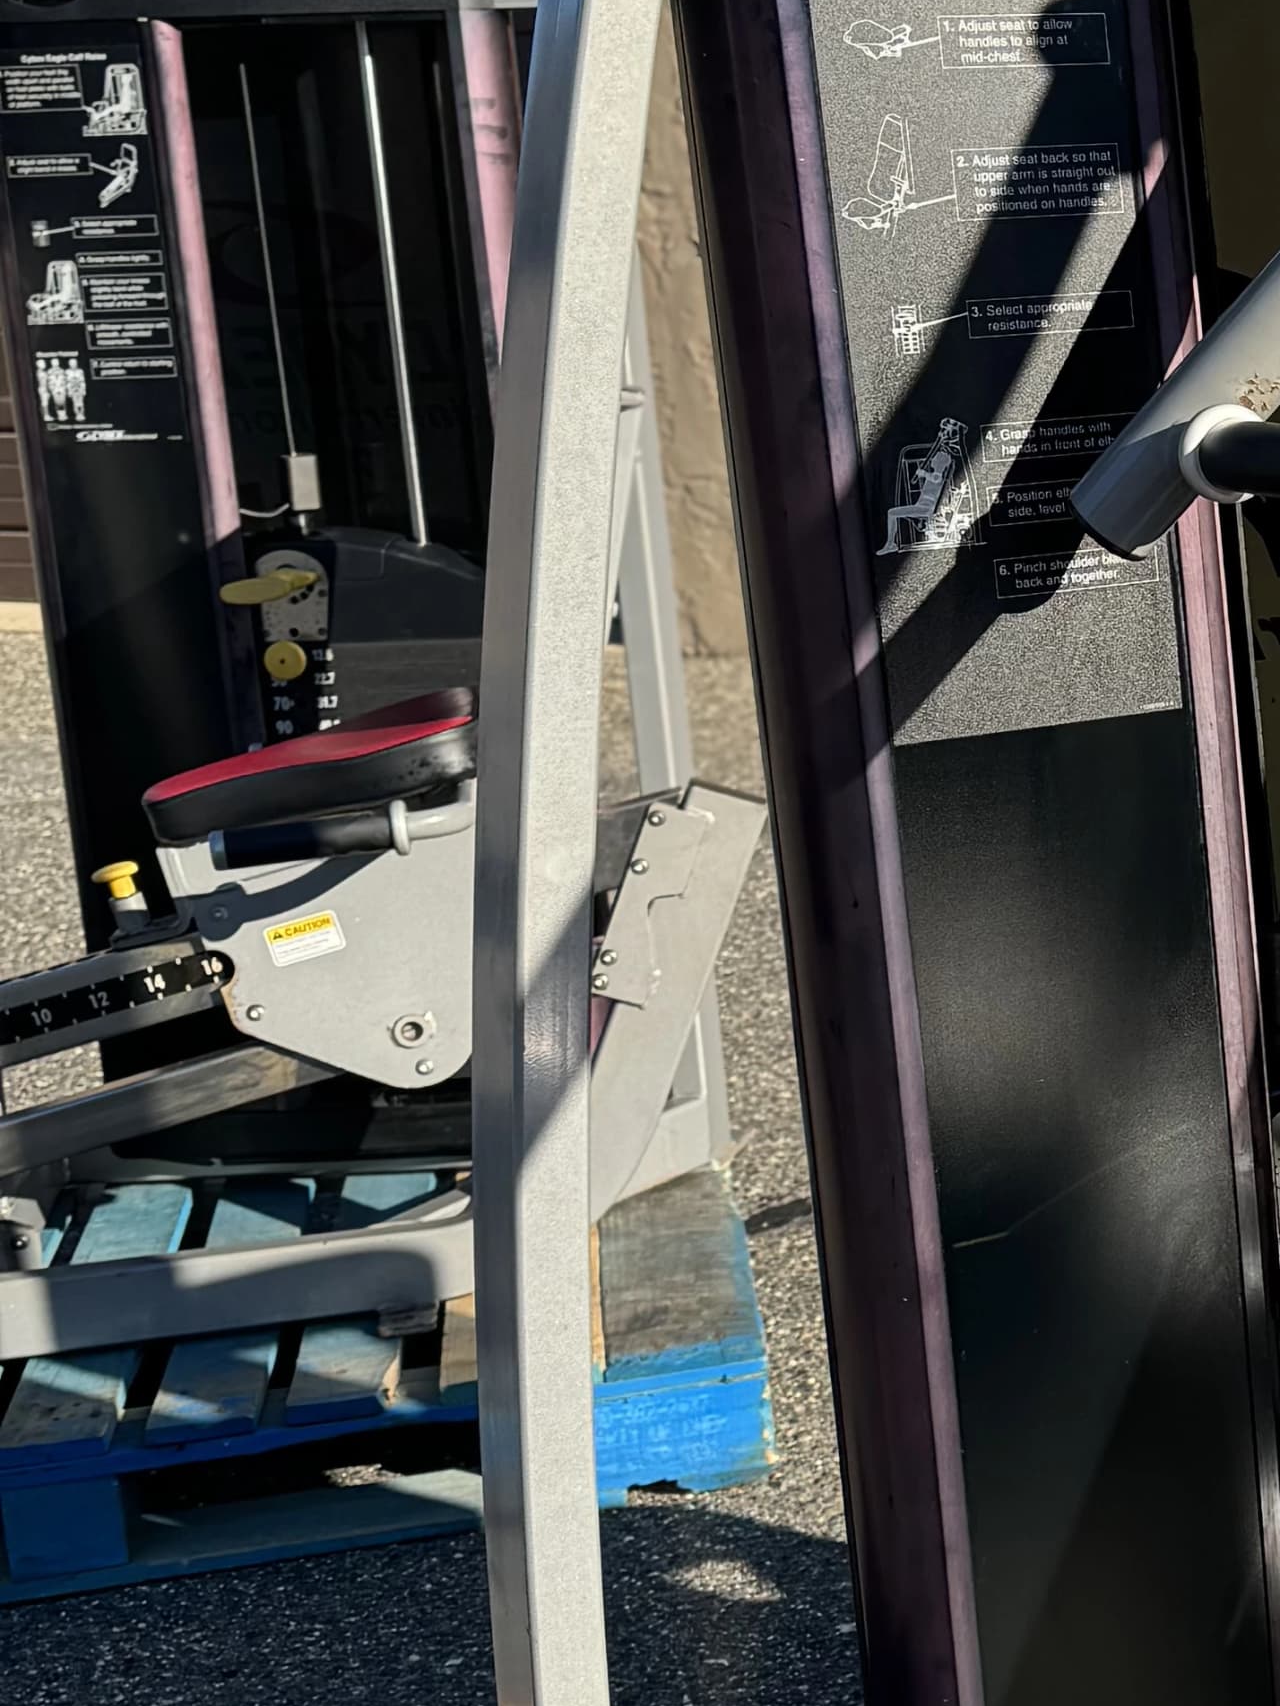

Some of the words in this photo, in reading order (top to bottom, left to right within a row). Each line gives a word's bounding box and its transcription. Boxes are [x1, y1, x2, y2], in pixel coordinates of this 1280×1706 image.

[943, 20, 954, 31] 1.
[959, 19, 997, 34] Adjust
[1000, 20, 1025, 31] seat
[1027, 19, 1039, 30] to
[1043, 18, 1072, 30] allow
[960, 35, 1007, 47] handles
[1010, 35, 1022, 46] to
[1026, 34, 1053, 48] align
[1057, 34, 1068, 45] at
[961, 50, 1024, 63] mid-chest.
[957, 157, 969, 167] 2.
[972, 154, 1010, 168] Adjust
[1012, 154, 1038, 165] seat
[1041, 152, 1069, 164] back
[1073, 153, 1086, 162] so
[1089, 151, 1111, 161] that
[974, 170, 1008, 184] upper
[1012, 170, 1035, 180] arm
[1039, 169, 1048, 179] is
[1051, 167, 1094, 180] straight
[1097, 166, 1116, 176] out
[975, 186, 986, 197] to
[990, 185, 1014, 196] side
[1018, 183, 1050, 195] when
[1053, 182, 1088, 193] hands
[1092, 183, 1110, 191] are
[976, 198, 1038, 214] positioned
[1041, 199, 1055, 209] on
[1059, 196, 1107, 208] handles.
[971, 307, 983, 317] 3.
[986, 304, 1023, 316] Select
[1027, 300, 1092, 315] appropriate
[988, 318, 1051, 331] resistance.
[985, 431, 998, 441] 4.
[1000, 428, 1036, 440] Grasp
[1039, 425, 1085, 436] handles
[1088, 422, 1111, 432] with
[1002, 442, 1038, 456] hands
[1041, 440, 1052, 451] in
[1055, 438, 1080, 449] front
[1084, 436, 1096, 448] of
[1007, 490, 1052, 502] Position
[1039, 503, 1065, 514] level
[999, 565, 1010, 575] 6.
[1014, 561, 1046, 574] Pinch
[1050, 556, 1099, 570] shoulder
[1016, 576, 1043, 588] back
[1046, 573, 1067, 584] and
[1070, 570, 1120, 583] together.
[285, 917, 330, 936] CAUTION
[31, 1008, 52, 1026] 10
[88, 992, 110, 1009] 12
[144, 974, 165, 993] 14
[201, 957, 223, 976] 16
